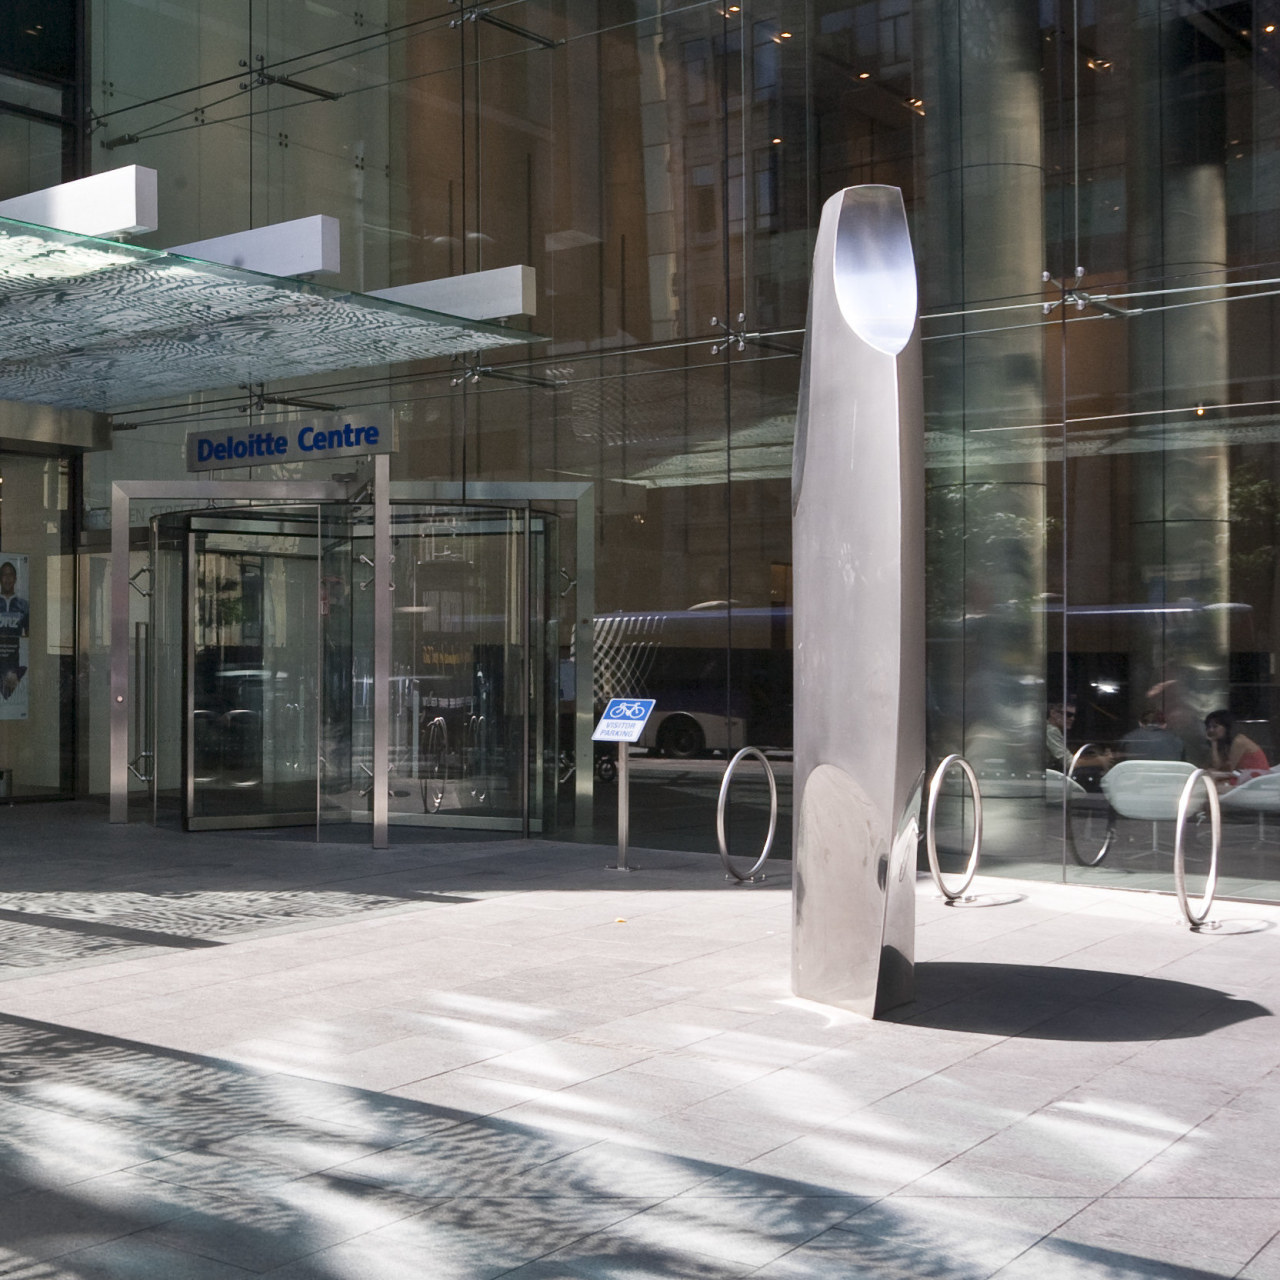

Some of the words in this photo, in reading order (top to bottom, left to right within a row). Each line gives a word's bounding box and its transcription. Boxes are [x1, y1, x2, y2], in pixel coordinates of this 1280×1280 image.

[197, 433, 288, 462] Deloitte
[297, 423, 379, 452] Centre
[104, 507, 145, 524] QEN
[606, 721, 636, 729] VISITOR
[600, 729, 633, 737] PARKING
